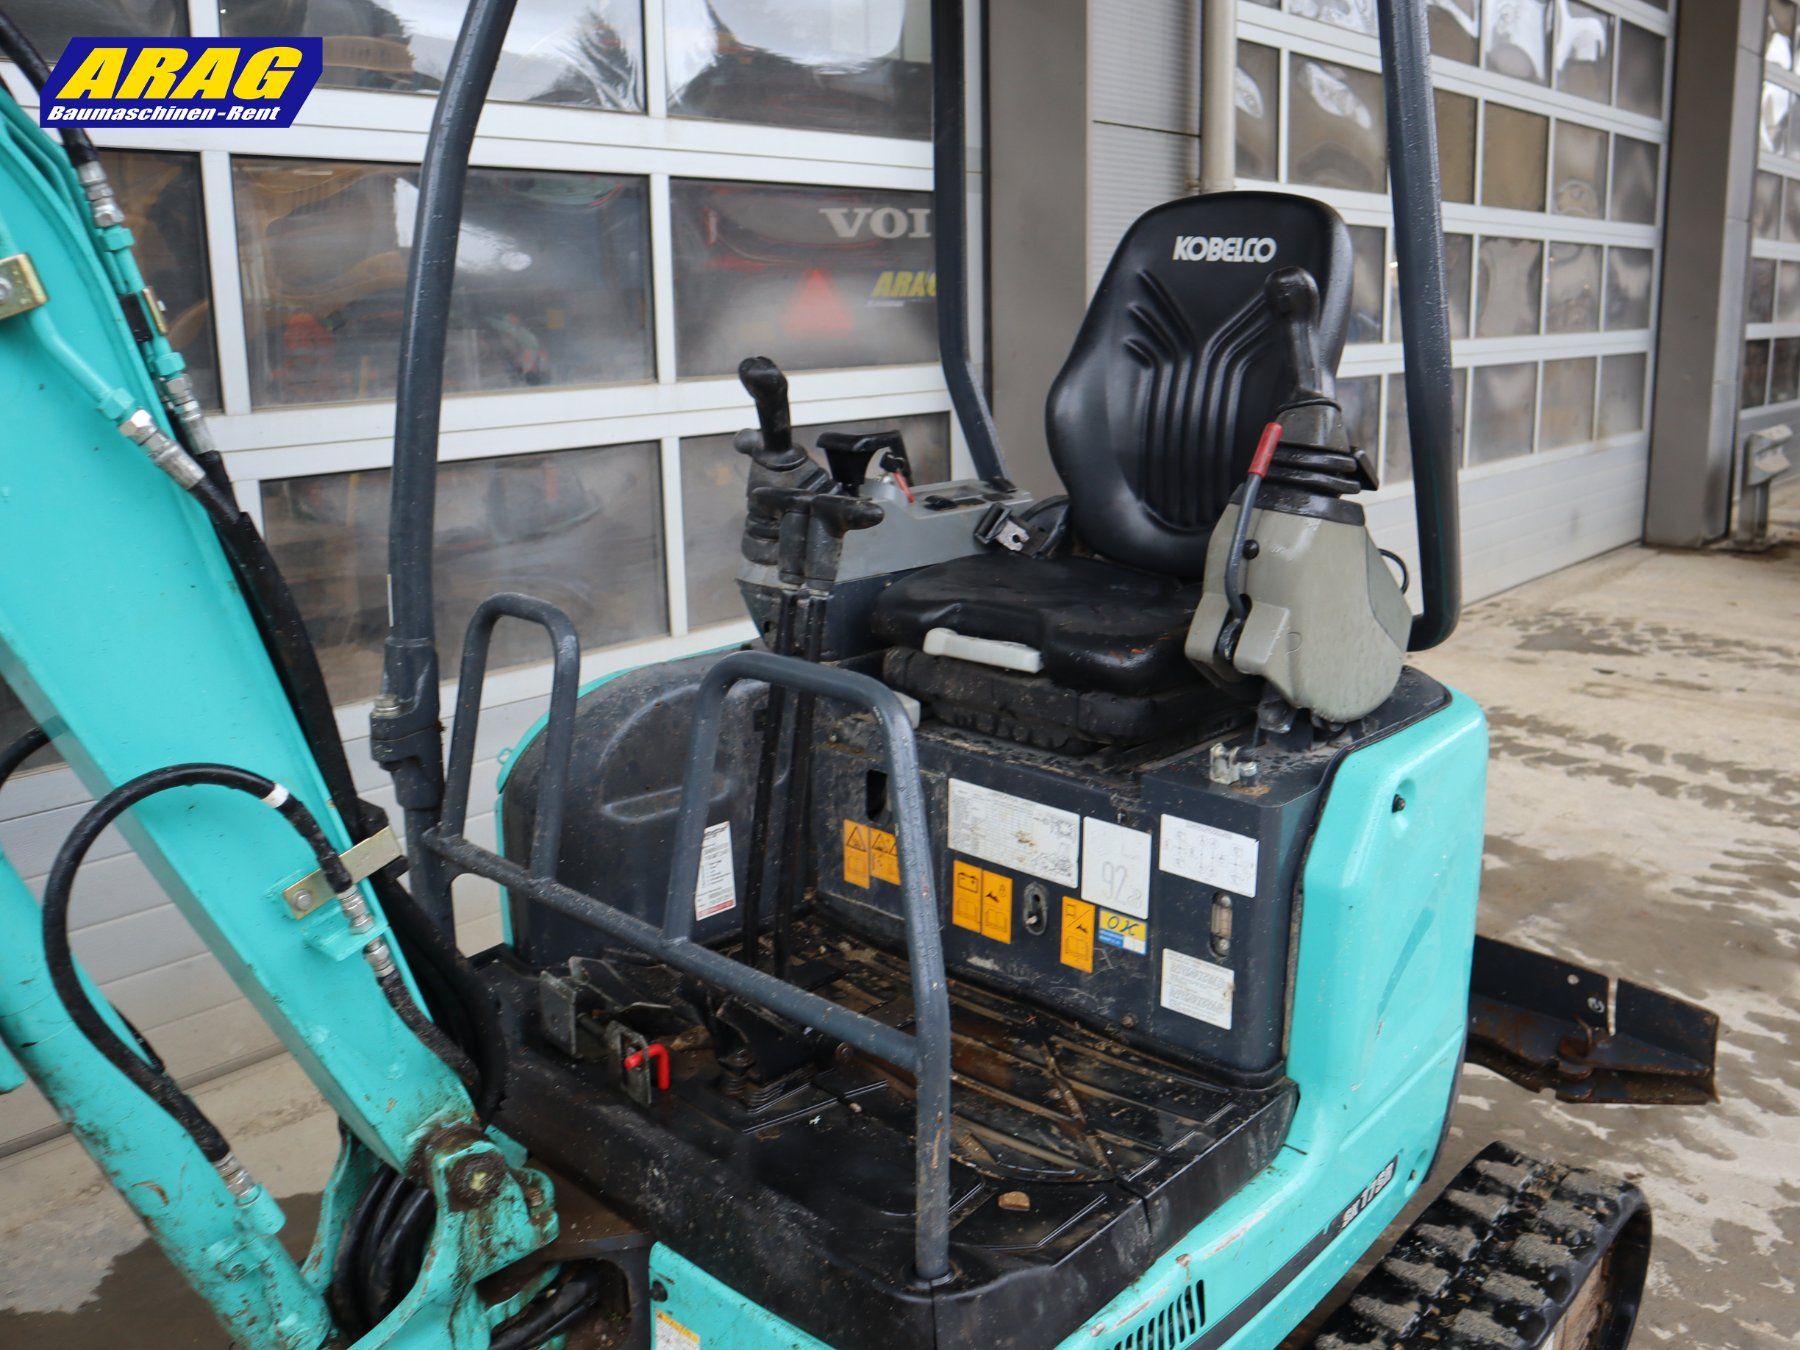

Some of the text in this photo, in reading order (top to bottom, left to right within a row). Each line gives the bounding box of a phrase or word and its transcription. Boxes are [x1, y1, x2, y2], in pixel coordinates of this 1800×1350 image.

[1172, 235, 1278, 263] KOBELCO
[1102, 861, 1128, 905] 92
[1107, 915, 1139, 937] OK
